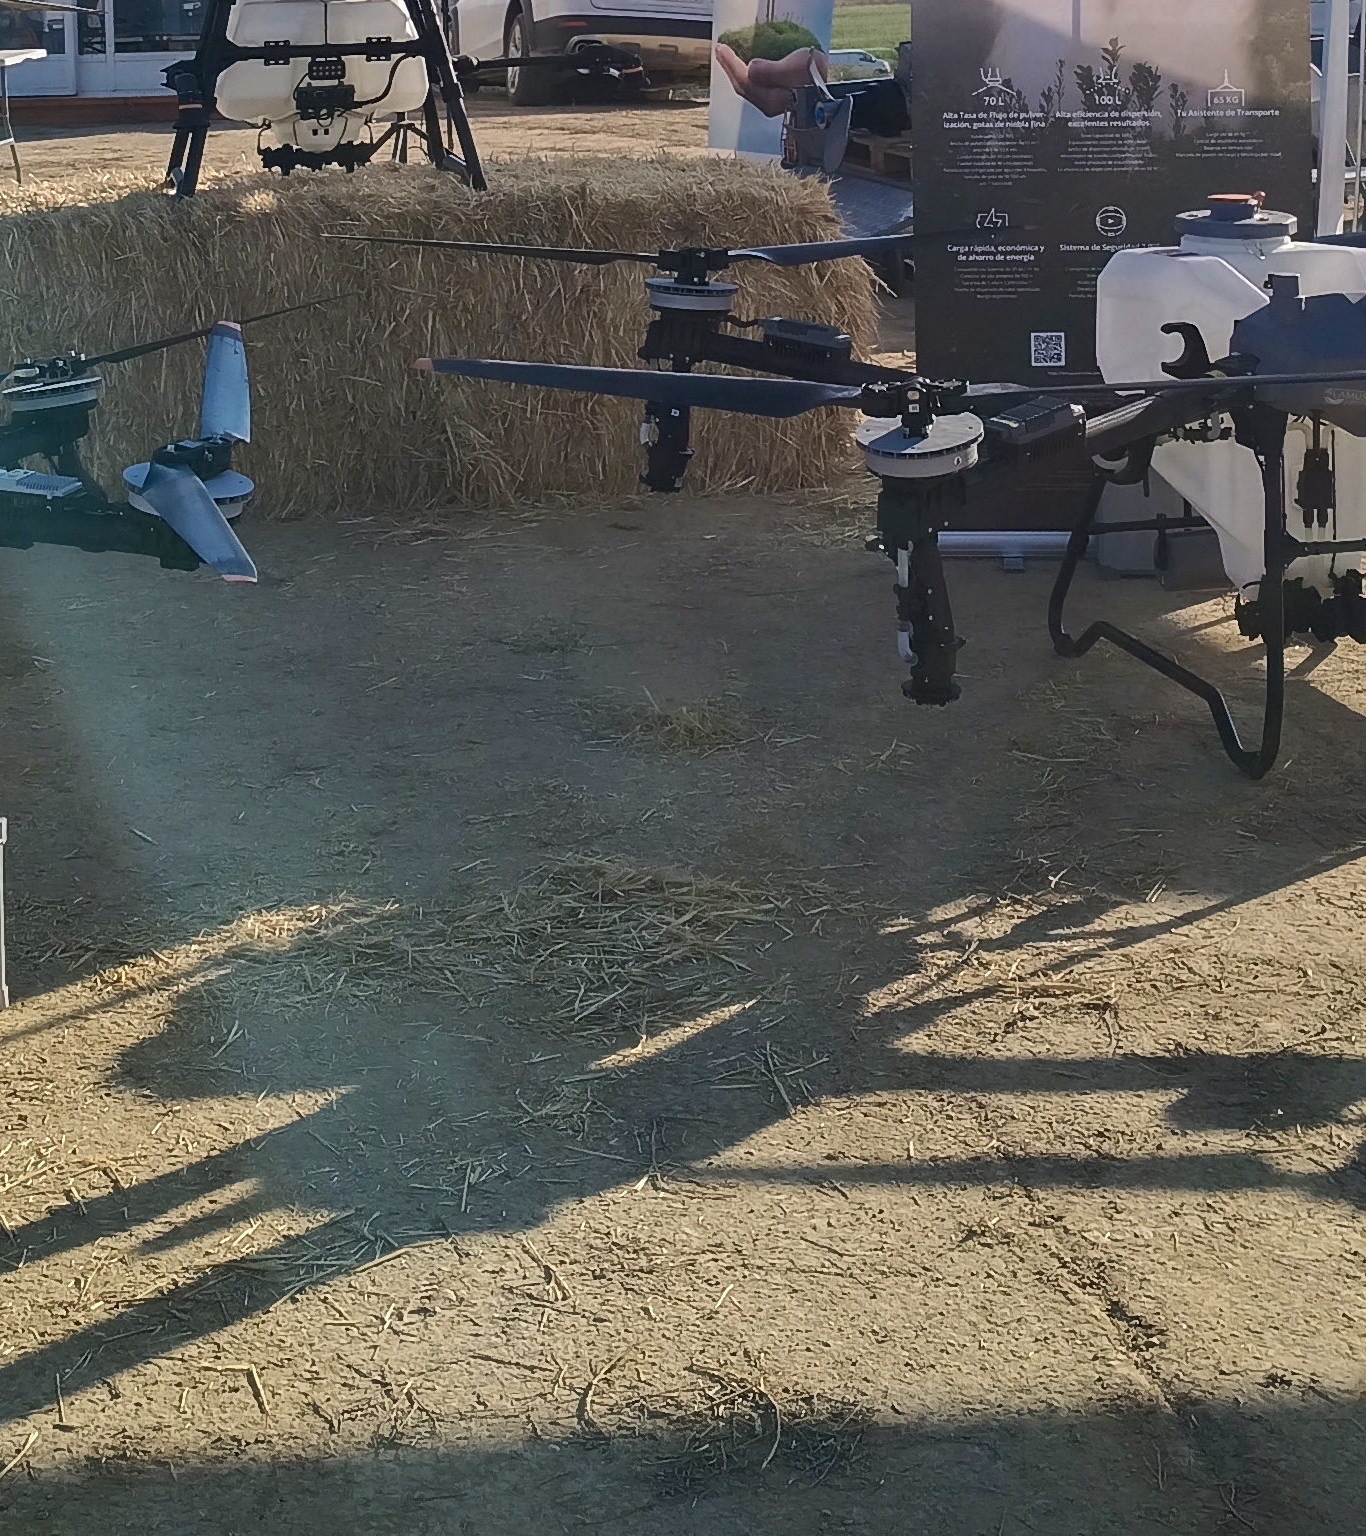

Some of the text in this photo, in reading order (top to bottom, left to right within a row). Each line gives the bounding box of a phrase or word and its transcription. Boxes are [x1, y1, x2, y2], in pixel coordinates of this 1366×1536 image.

[984, 96, 1004, 105] 70 L
[1095, 96, 1121, 105] 100 L
[1226, 96, 1239, 104] KG
[978, 111, 987, 119] de
[1008, 111, 1018, 119] de
[1110, 110, 1119, 118] de
[1188, 109, 1224, 117] Asistente
[1226, 109, 1235, 117] de
[1237, 109, 1280, 118] Transporte
[995, 120, 1004, 128] de
[947, 244, 968, 253] Carga
[1060, 244, 1089, 252] Sistema
[1091, 243, 1100, 252] de
[995, 253, 1005, 261] de
